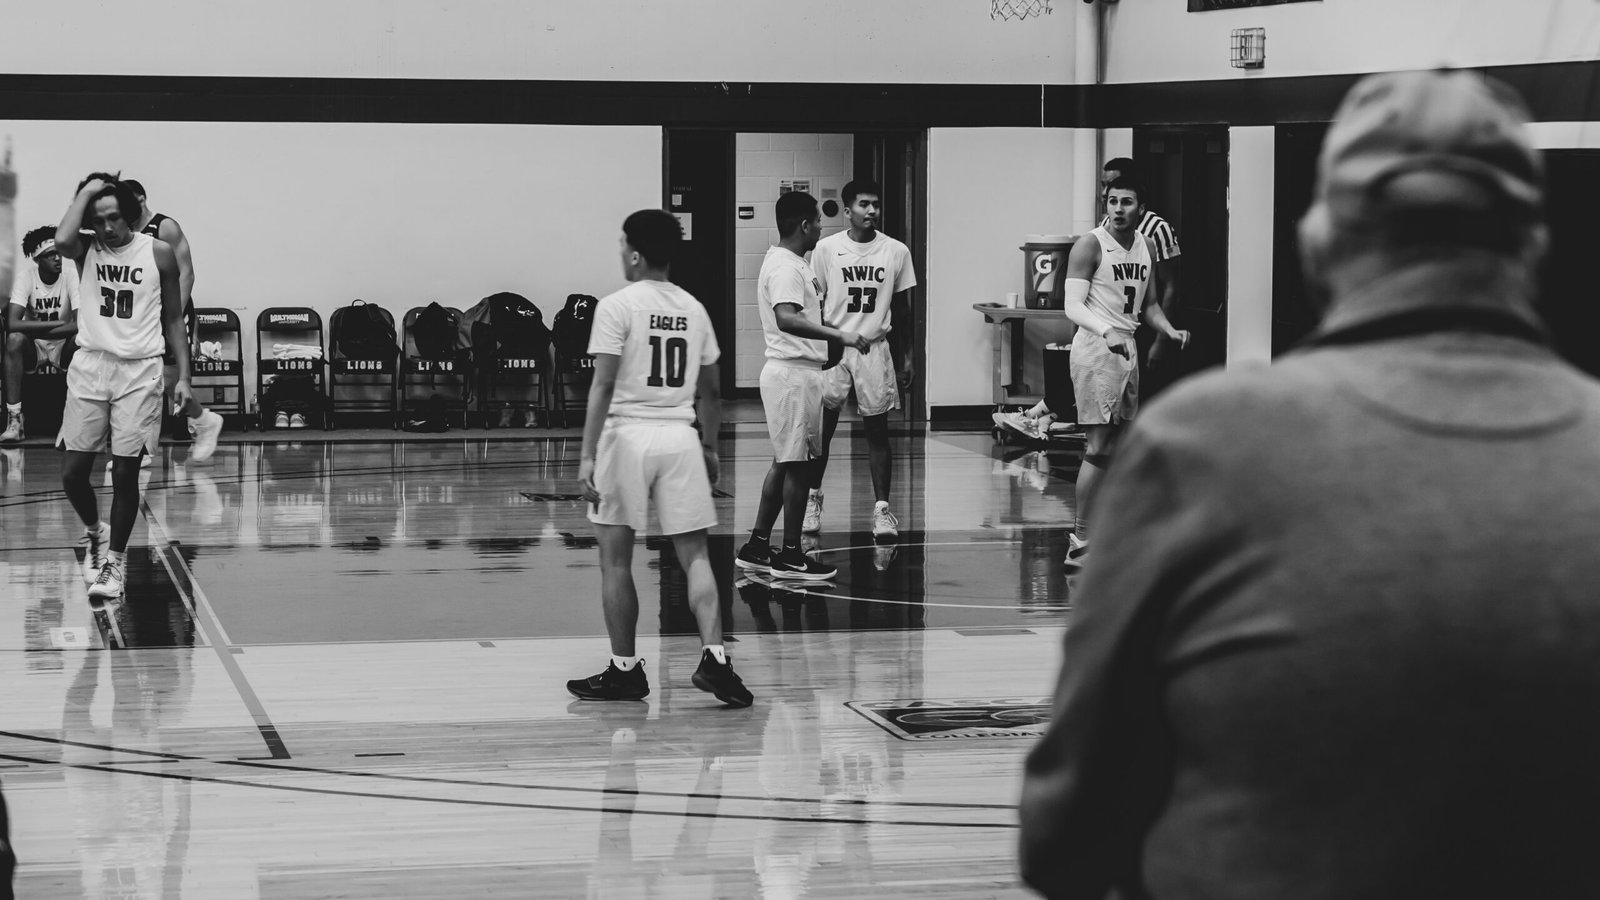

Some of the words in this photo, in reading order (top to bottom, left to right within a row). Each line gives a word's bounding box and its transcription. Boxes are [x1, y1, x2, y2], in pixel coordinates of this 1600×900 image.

[1035, 254, 1052, 274] G
[1111, 262, 1148, 282] NWIC
[96, 263, 143, 285] NWIC
[841, 265, 885, 284] NWIC
[100, 286, 134, 319] 30
[847, 287, 878, 313] 33
[649, 314, 688, 331] EAGLES
[194, 362, 230, 371] LIONS
[277, 361, 313, 370] LIONS
[347, 361, 383, 370] LIONS
[418, 361, 453, 371] LINS
[647, 335, 688, 388] 10
